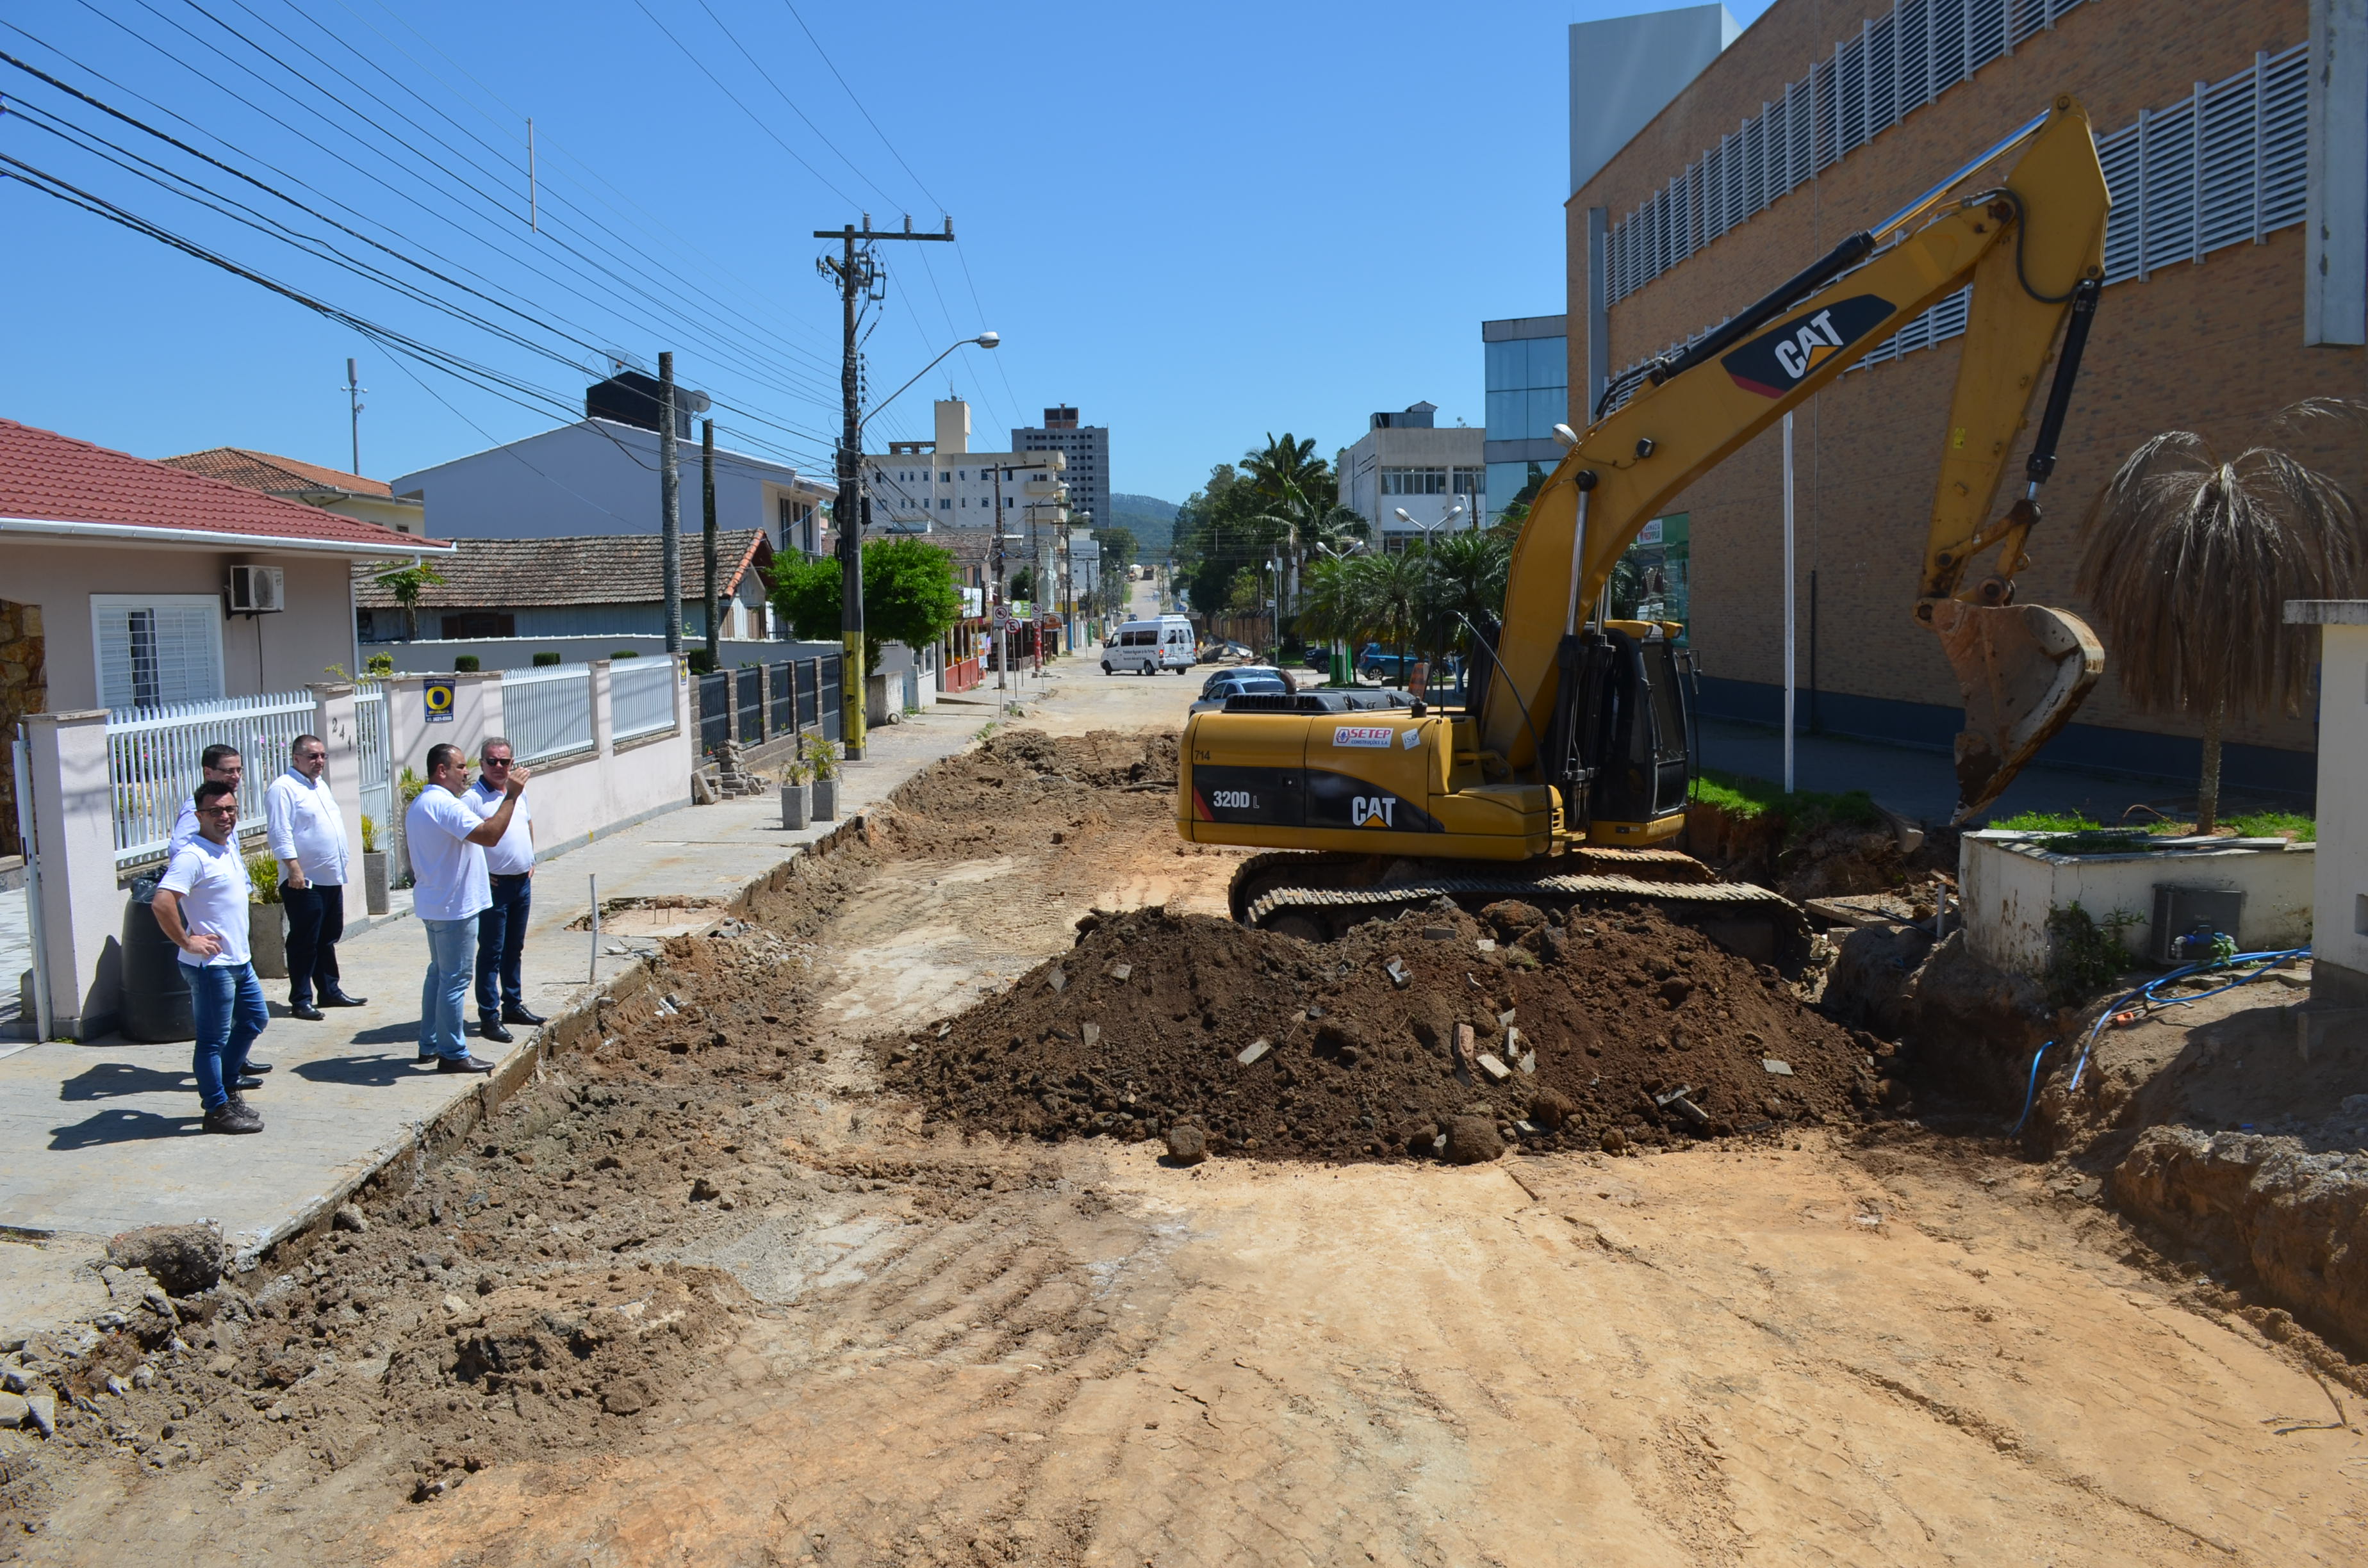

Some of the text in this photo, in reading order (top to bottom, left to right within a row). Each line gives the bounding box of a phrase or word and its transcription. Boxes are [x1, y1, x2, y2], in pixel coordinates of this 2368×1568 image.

[1775, 309, 1844, 379] CAT
[332, 717, 351, 752] 241
[1351, 729, 1391, 739] SETEP
[1404, 734, 1417, 743] ISO
[1195, 750, 1210, 760] 714
[1213, 790, 1260, 809] 320D L
[1353, 796, 1396, 827] CAT
